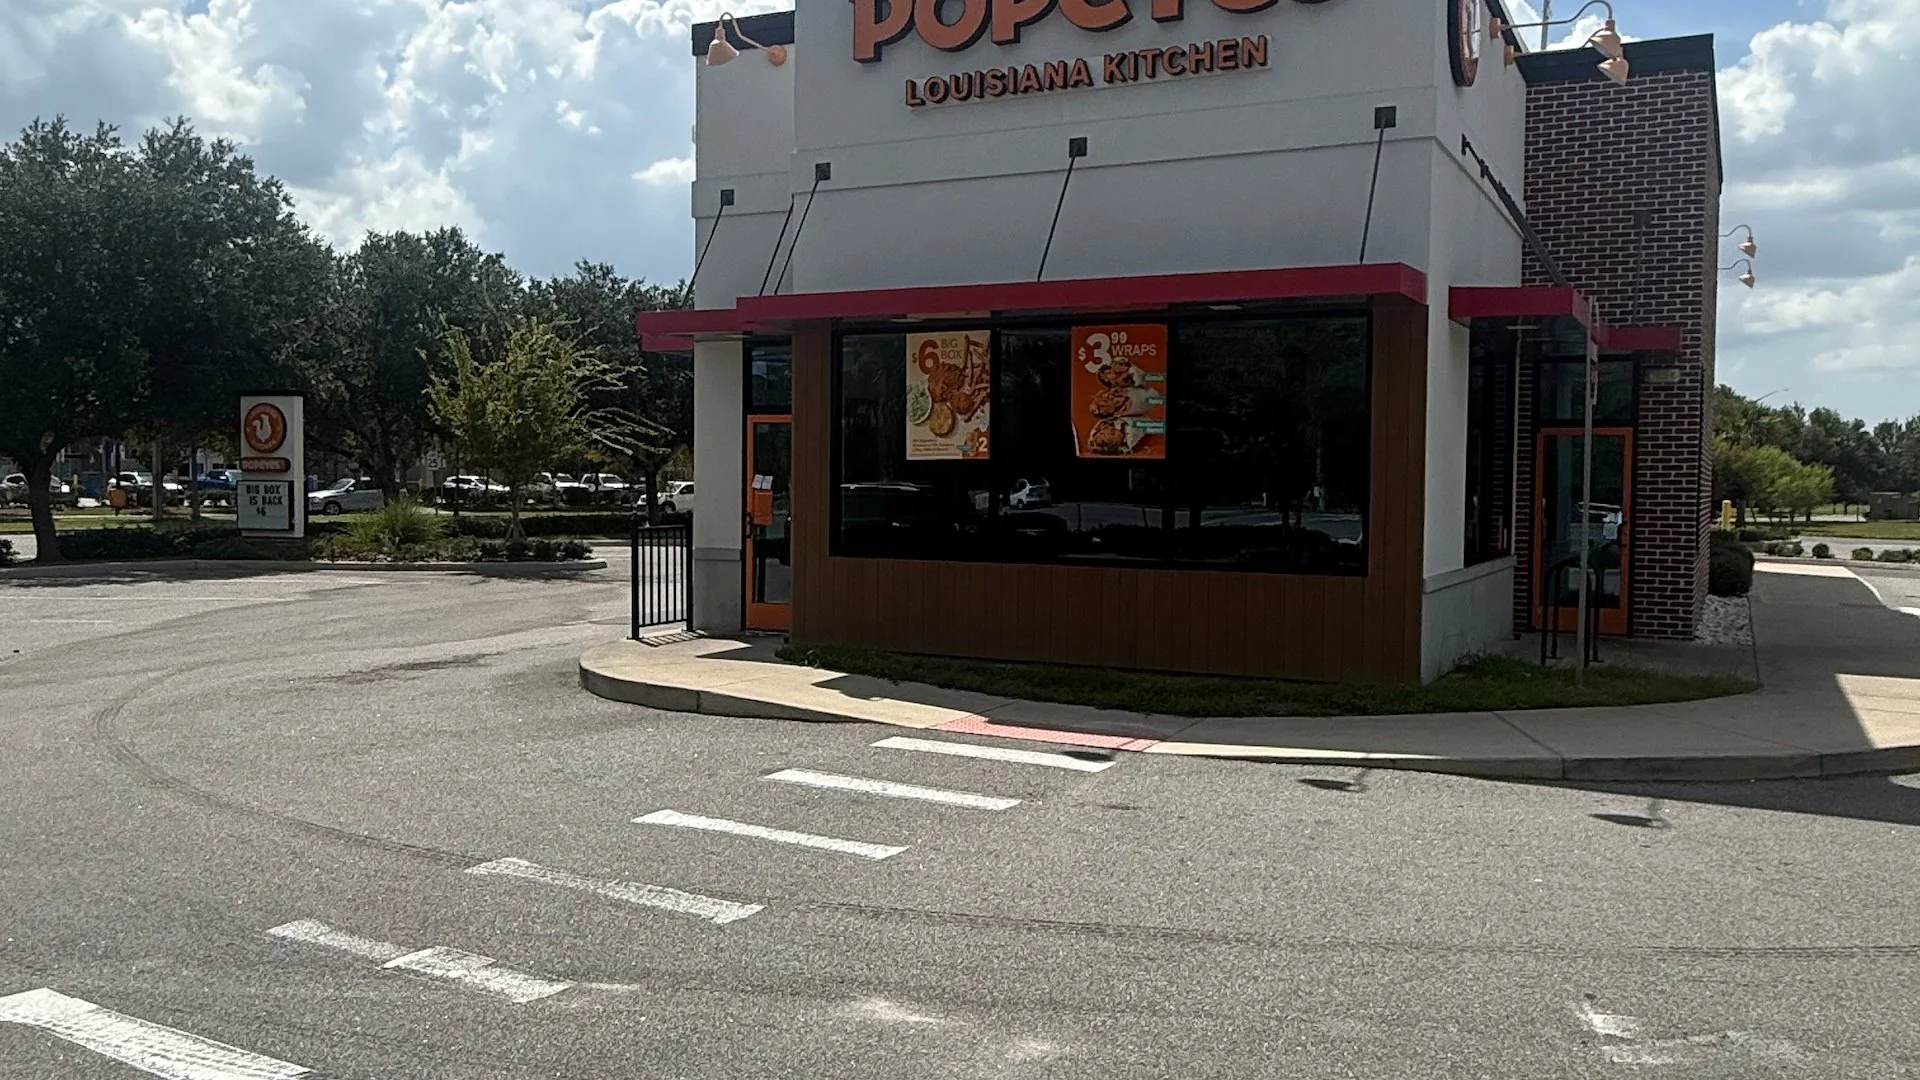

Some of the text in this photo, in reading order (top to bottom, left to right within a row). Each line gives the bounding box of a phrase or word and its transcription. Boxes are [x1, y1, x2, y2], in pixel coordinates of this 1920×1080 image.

[905, 35, 1268, 107] LOUISIANA KITCHEN
[941, 338, 958, 348] BIG
[941, 349, 962, 360] BOX
[1111, 344, 1157, 357] WRAPS
[242, 460, 281, 470] POPEYES
[246, 485, 281, 495] BIG BOX
[249, 496, 283, 505] IS BACK
